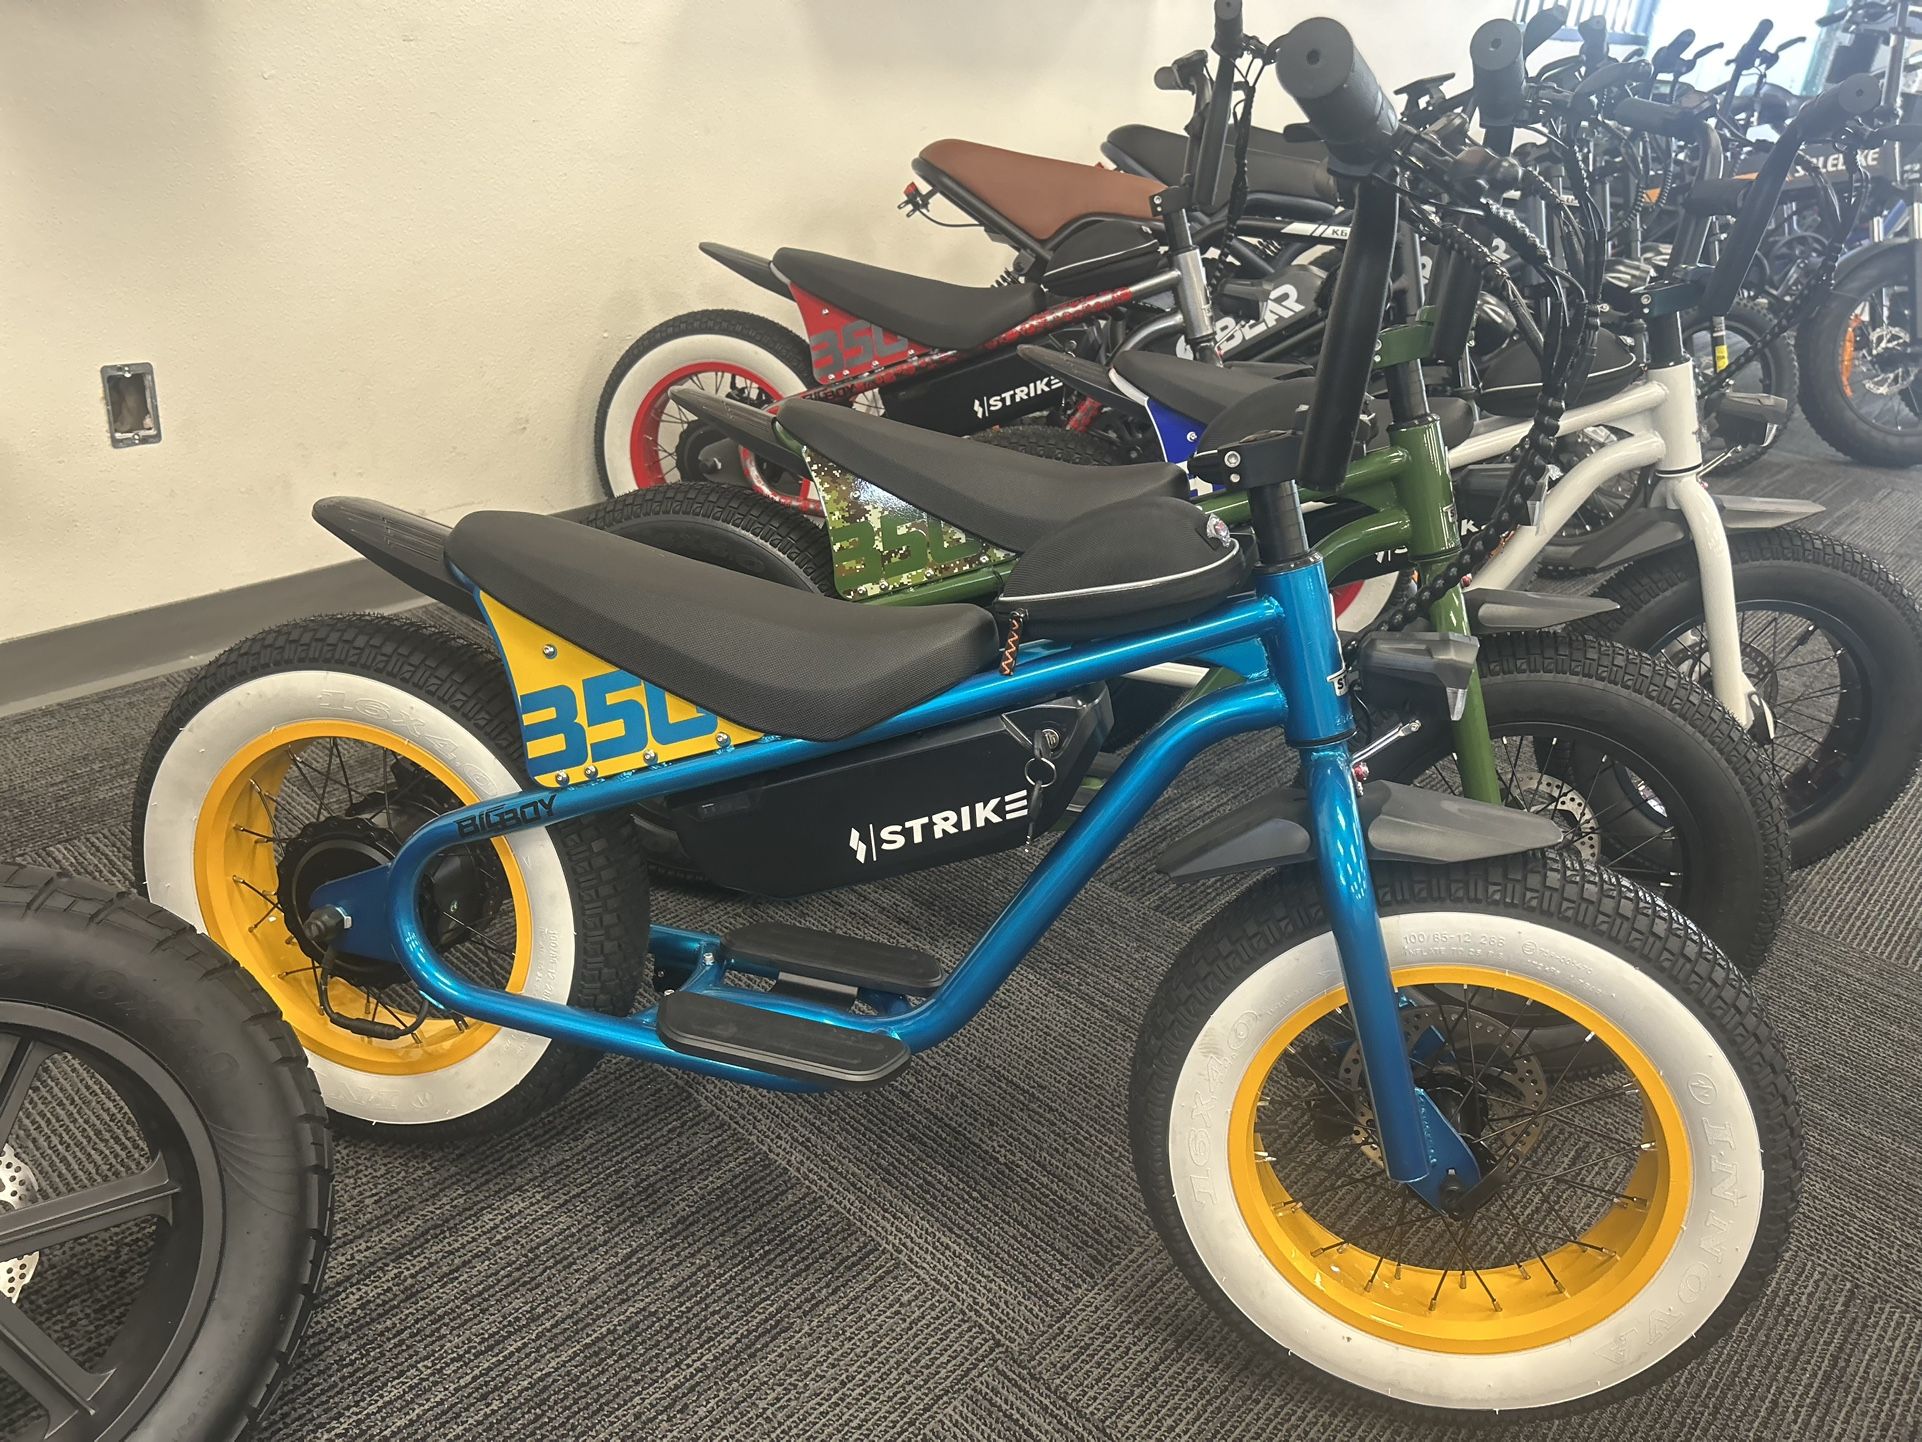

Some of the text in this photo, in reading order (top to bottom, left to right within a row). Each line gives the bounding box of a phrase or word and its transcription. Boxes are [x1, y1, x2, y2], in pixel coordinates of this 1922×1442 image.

[989, 376, 1064, 412] STRIKE
[832, 512, 982, 590] 350
[520, 670, 718, 777] 350
[454, 795, 558, 838] BIGBOY
[880, 789, 1028, 851] STRIKE
[1592, 1117, 1742, 1367] INNOVA
